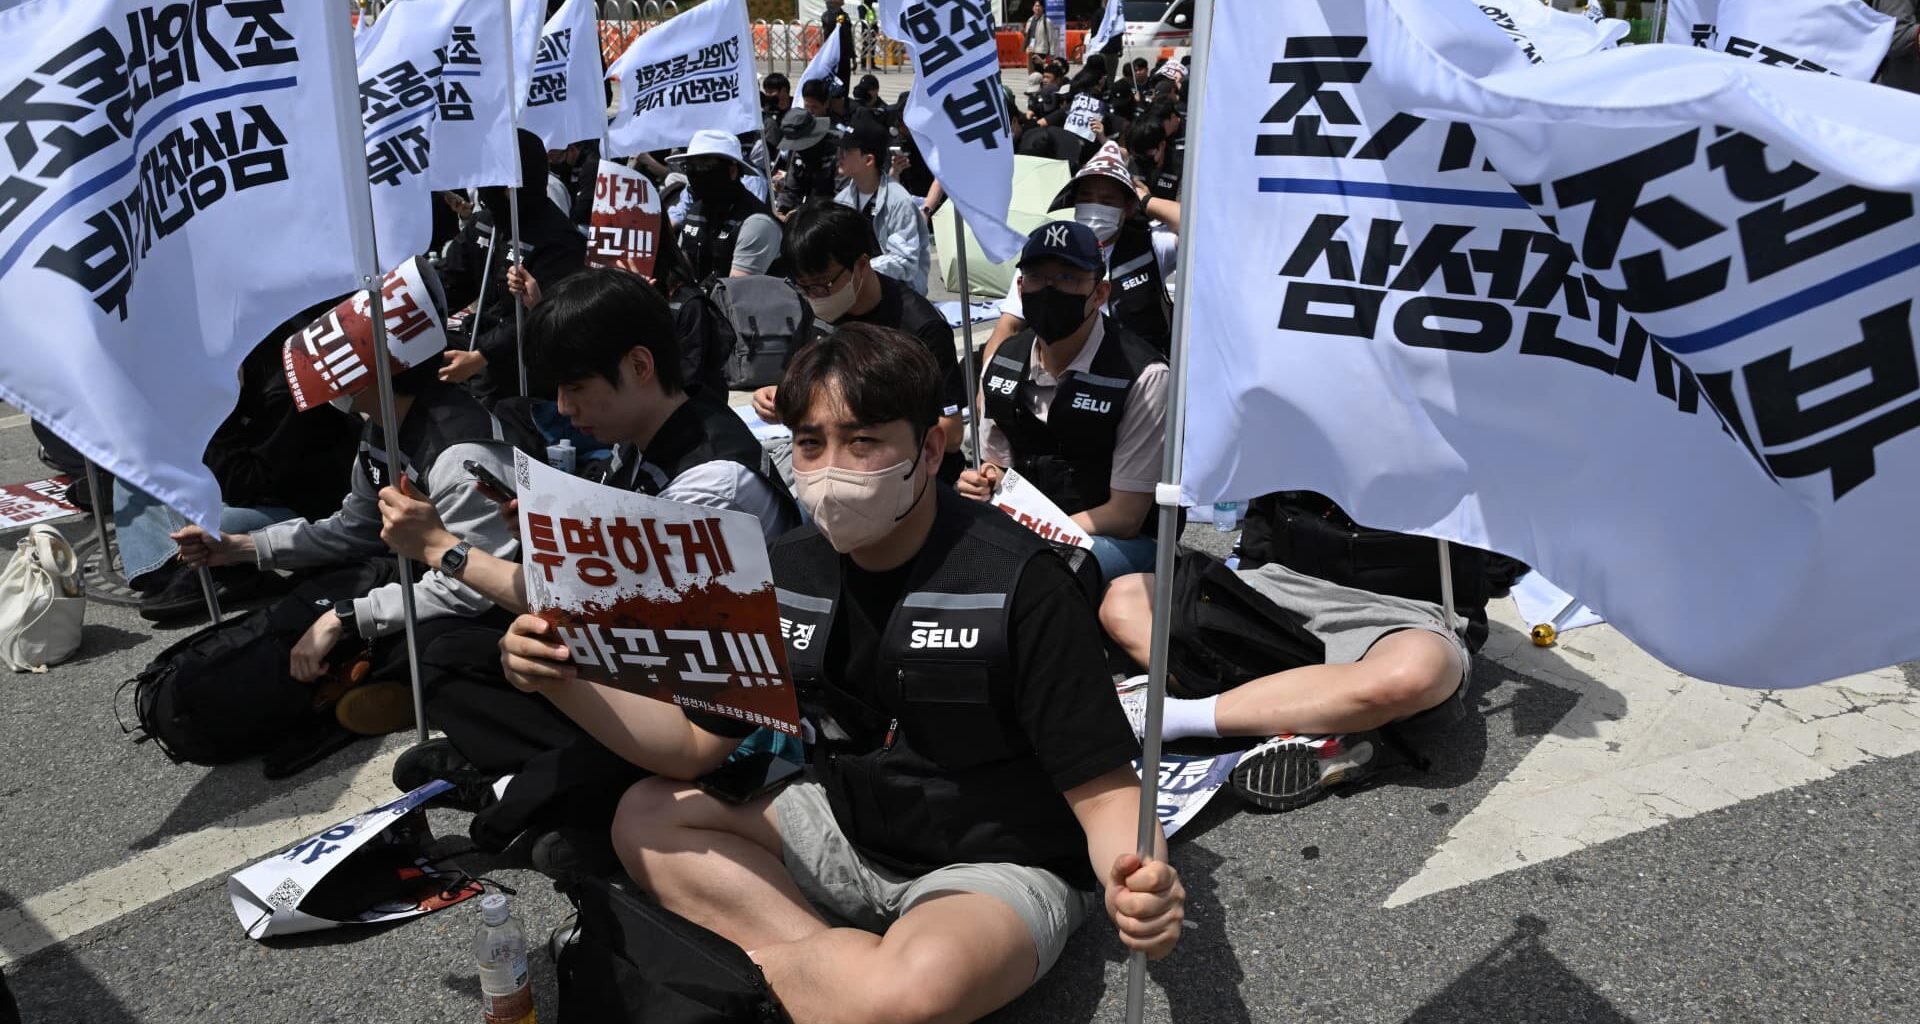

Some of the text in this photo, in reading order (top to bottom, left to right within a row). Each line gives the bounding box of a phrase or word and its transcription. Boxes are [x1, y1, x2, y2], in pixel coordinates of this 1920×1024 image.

[1044, 224, 1069, 247] NY
[1122, 272, 1149, 291] SELU
[303, 311, 369, 391] 고!!!
[987, 375, 1018, 395] 투쟁
[1071, 392, 1111, 414] SELU
[527, 511, 737, 589] 투명하게
[910, 621, 979, 650] SELU
[556, 622, 785, 688] 바꾸고!!!
[672, 693, 798, 734] 삼성전자노동조합 공동투쟁본부
